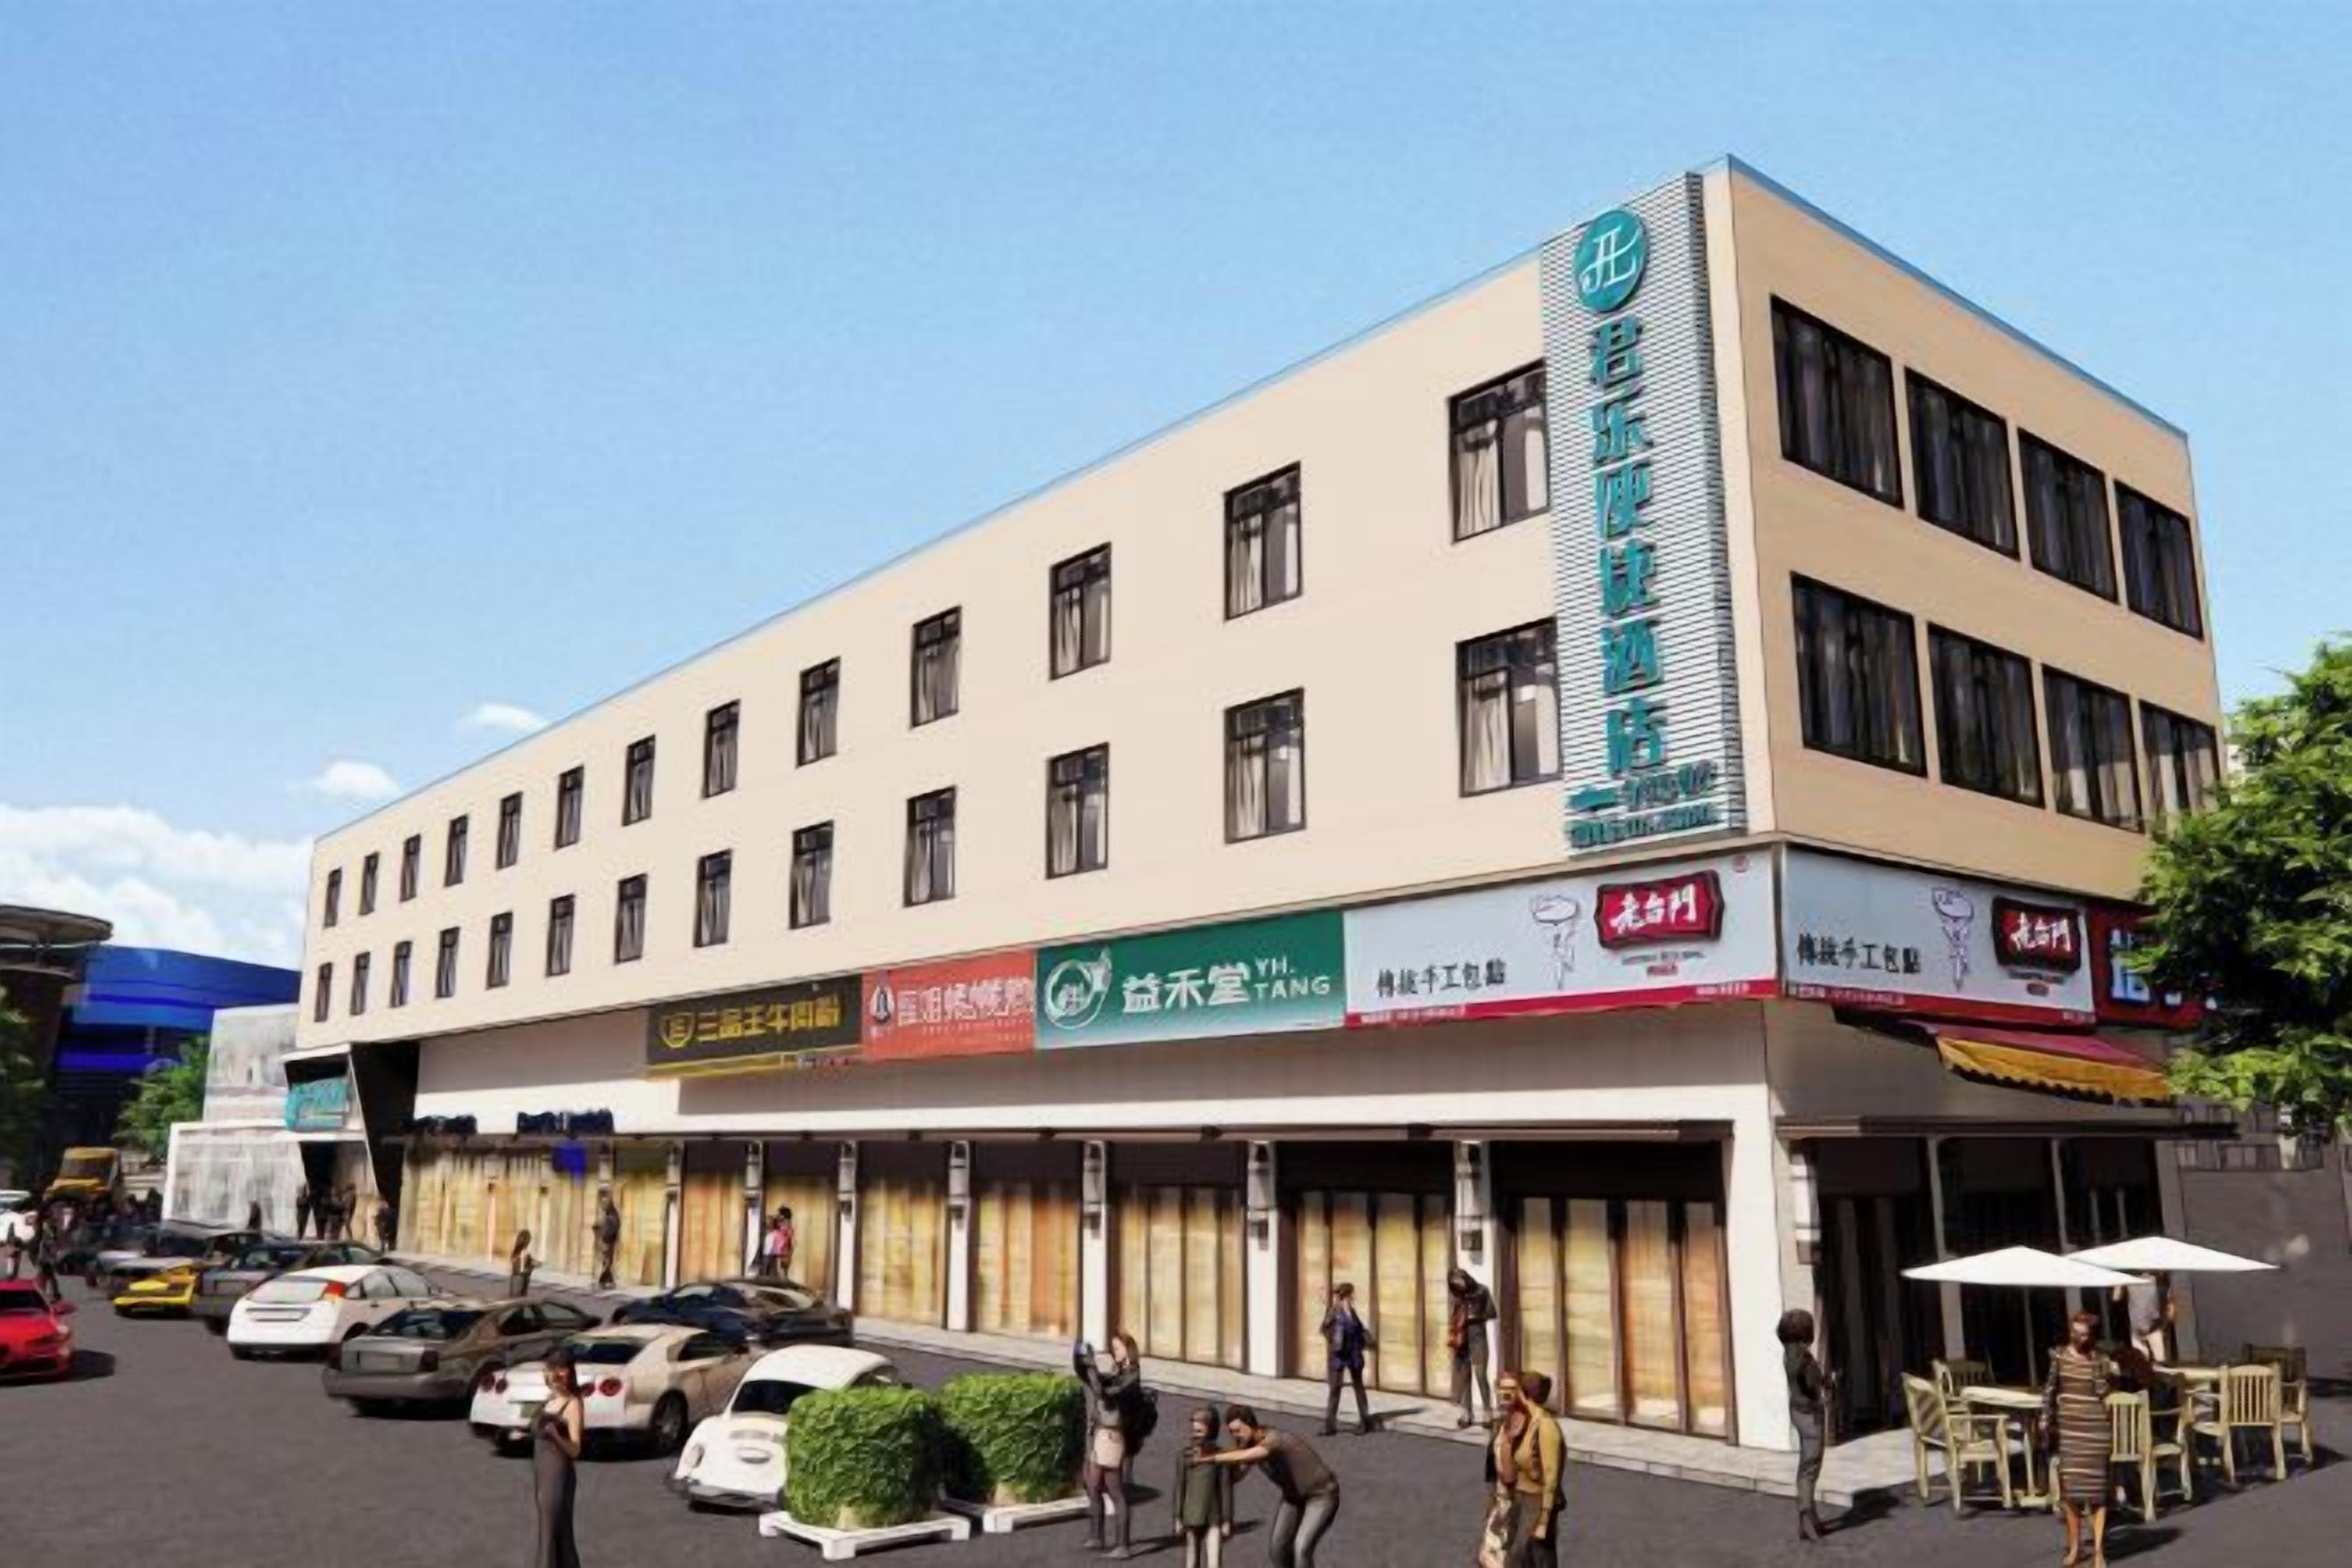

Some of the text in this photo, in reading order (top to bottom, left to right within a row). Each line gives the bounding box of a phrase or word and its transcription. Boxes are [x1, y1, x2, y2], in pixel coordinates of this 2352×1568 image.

[1122, 961, 1251, 1014] 益禾堂
[1254, 976, 1331, 999] TANG
